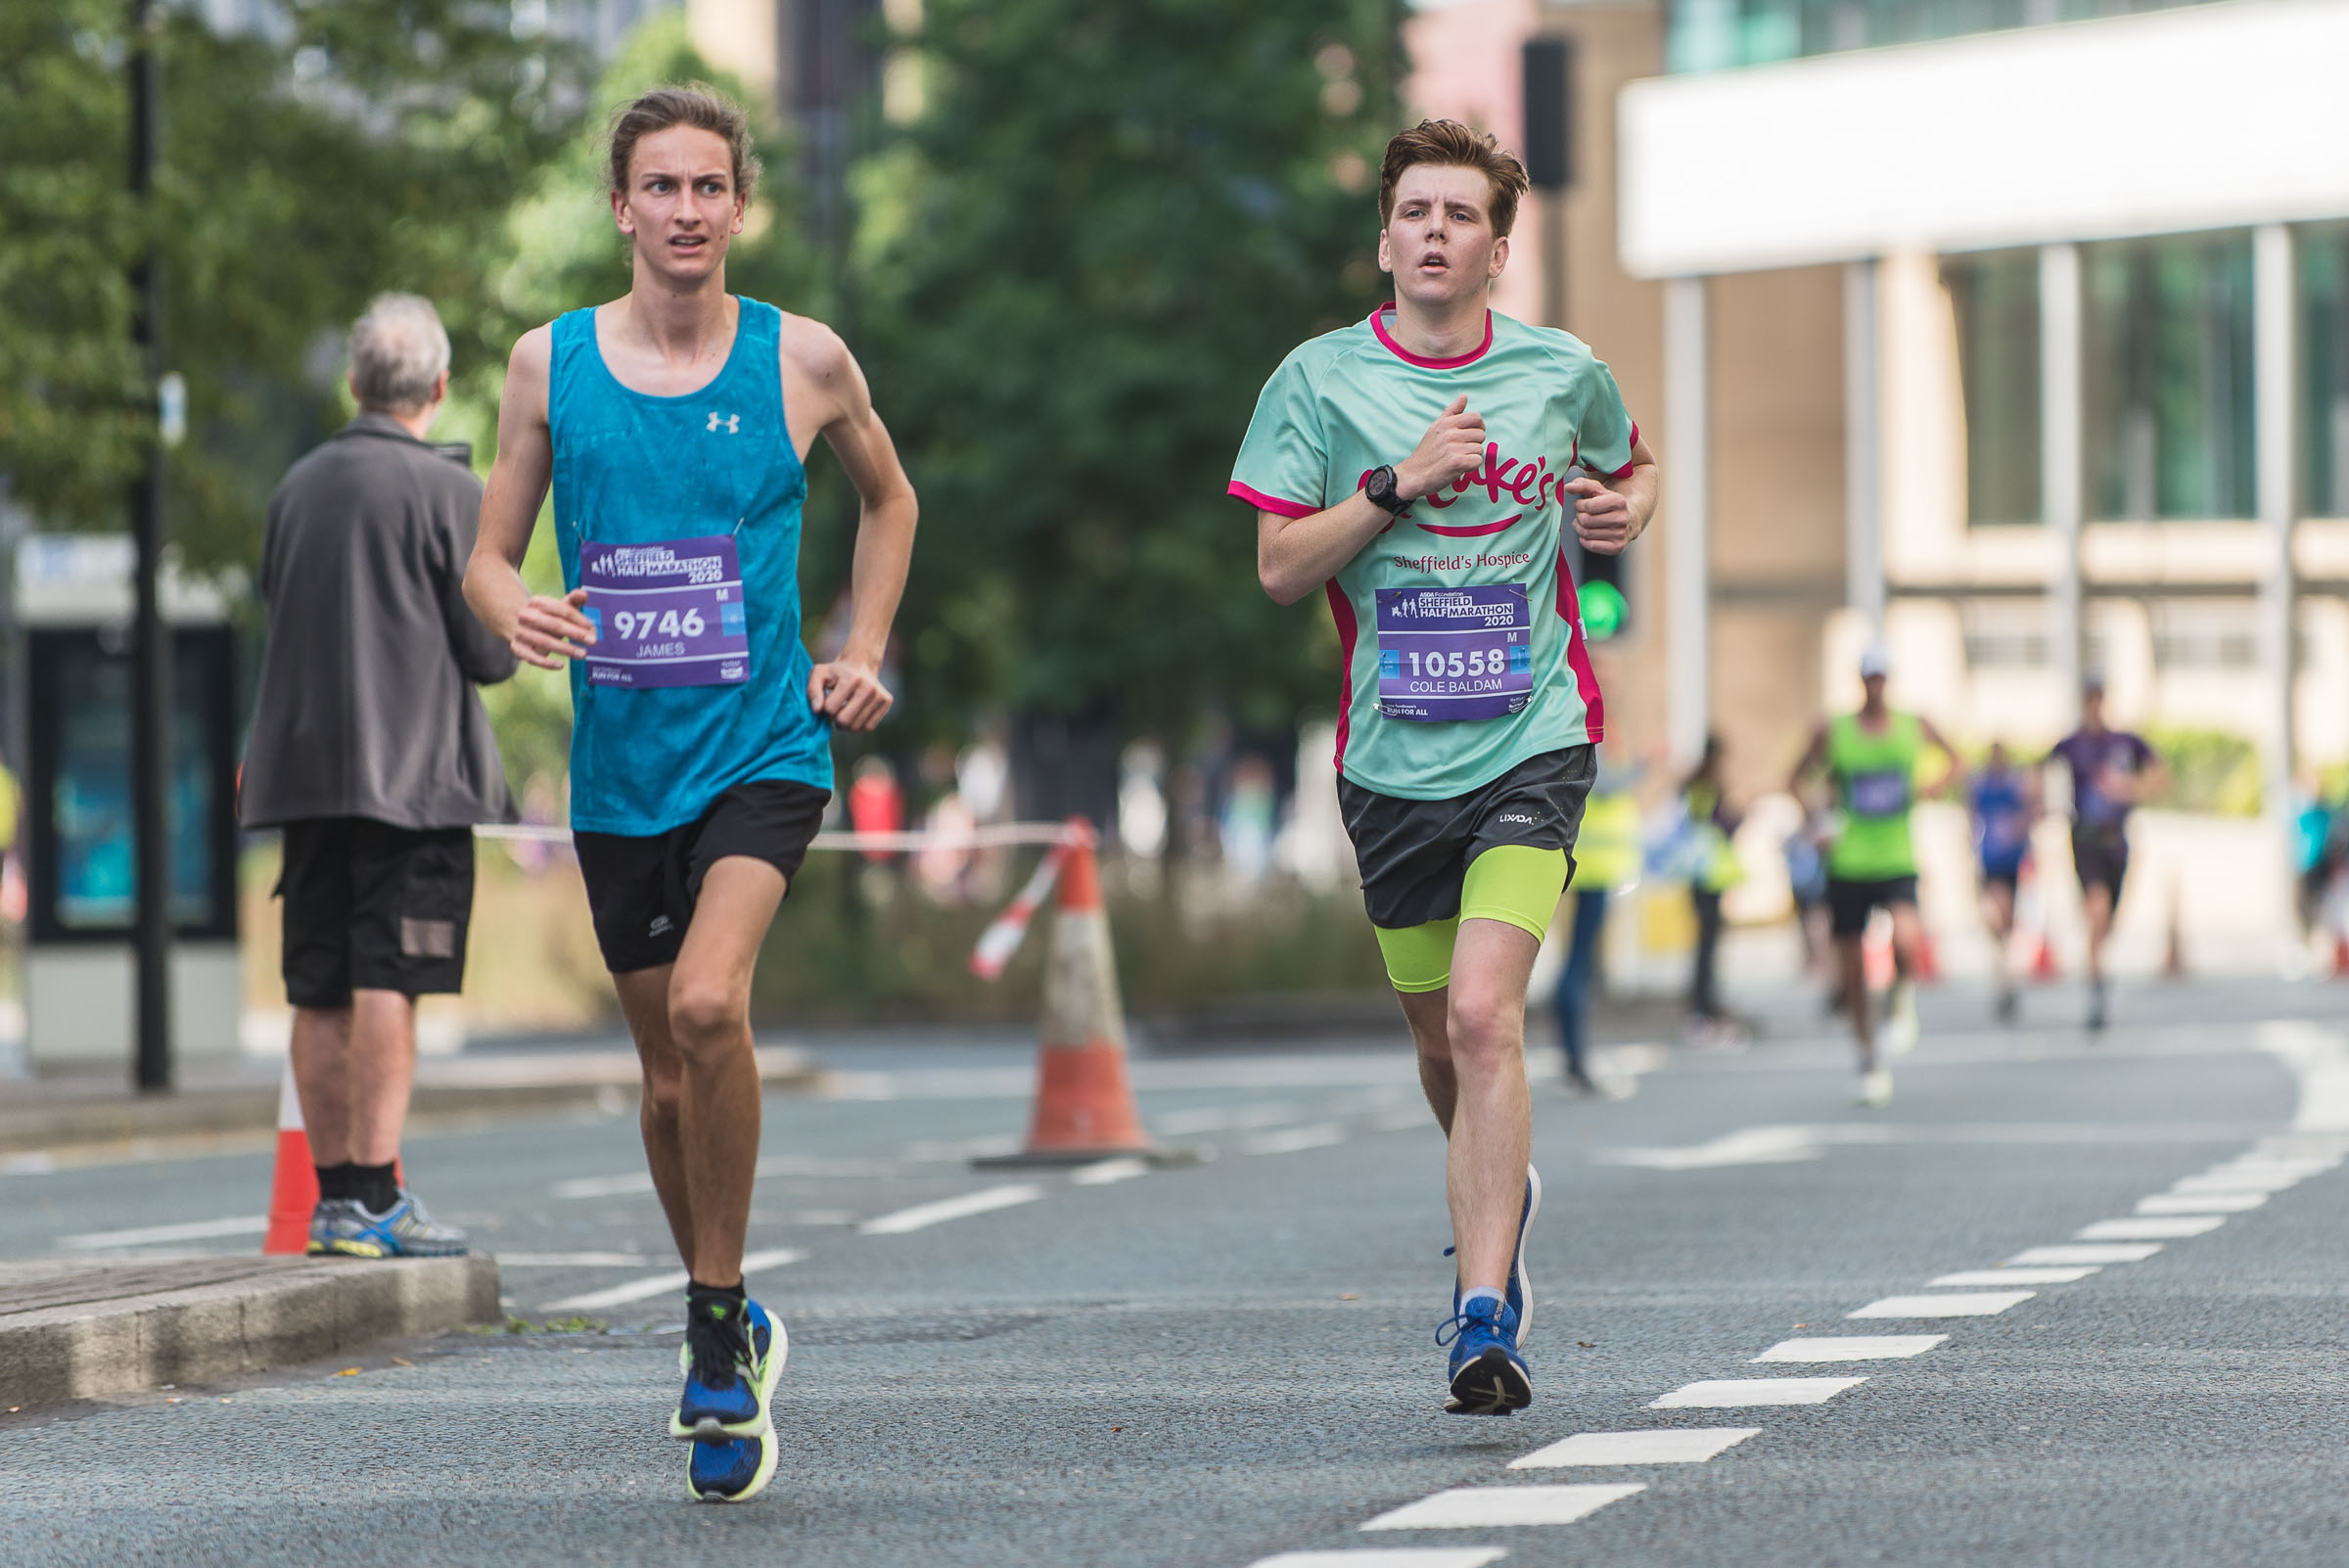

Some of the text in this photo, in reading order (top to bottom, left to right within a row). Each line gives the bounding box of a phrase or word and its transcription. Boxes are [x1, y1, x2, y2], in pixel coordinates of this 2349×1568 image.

[1394, 551, 1530, 574] Sheffield's Hospice
[687, 569, 722, 583] 2020
[715, 588, 729, 602] M
[1420, 597, 1471, 608] SHEFFIELD
[1420, 604, 1512, 618] HALF MARATHON
[614, 608, 705, 640] 9746
[1484, 616, 1514, 626] 2020
[1507, 631, 1518, 643] M
[636, 641, 686, 659] JAMES
[1408, 648, 1505, 677] 10558
[1409, 678, 1502, 693] COLE BALDAM
